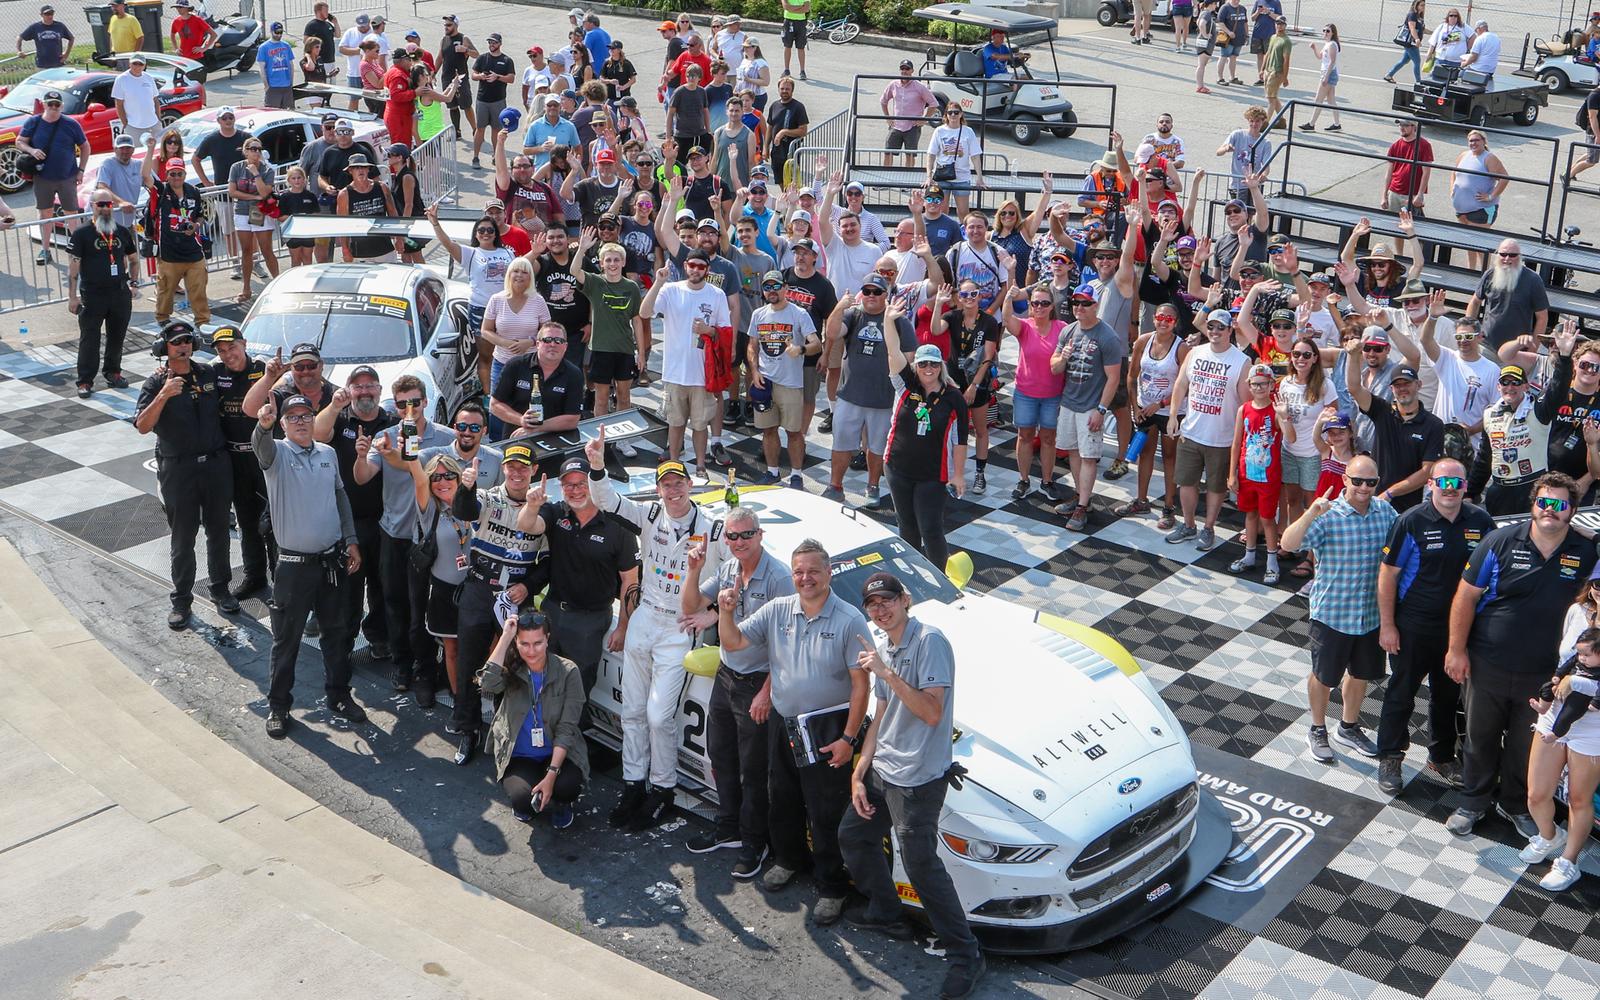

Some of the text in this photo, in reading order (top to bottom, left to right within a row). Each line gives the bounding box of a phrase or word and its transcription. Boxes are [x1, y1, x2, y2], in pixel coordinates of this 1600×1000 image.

[960, 98, 974, 108] 607
[513, 187, 547, 202] LEGENDS
[591, 255, 600, 264] OL
[546, 272, 561, 283] OLD
[355, 295, 369, 303] 10
[784, 290, 816, 305] LLIOTT
[1190, 301, 1204, 311] 48
[1193, 358, 1232, 376] SORRY
[1194, 375, 1210, 384] CAN'T
[1210, 378, 1228, 388] HEAR
[1191, 382, 1226, 398] YOU OVER
[604, 420, 636, 437] CBD
[1491, 438, 1532, 449] Racing
[487, 521, 543, 542] THETFORD
[488, 533, 529, 552] NORCOLD
[889, 542, 906, 554] 20
[648, 549, 686, 571] ALTWE
[683, 699, 706, 757] 2
[1032, 712, 1128, 768] ALTWELL
[1121, 779, 1138, 793] Ford
[1248, 792, 1334, 827] ROAD
